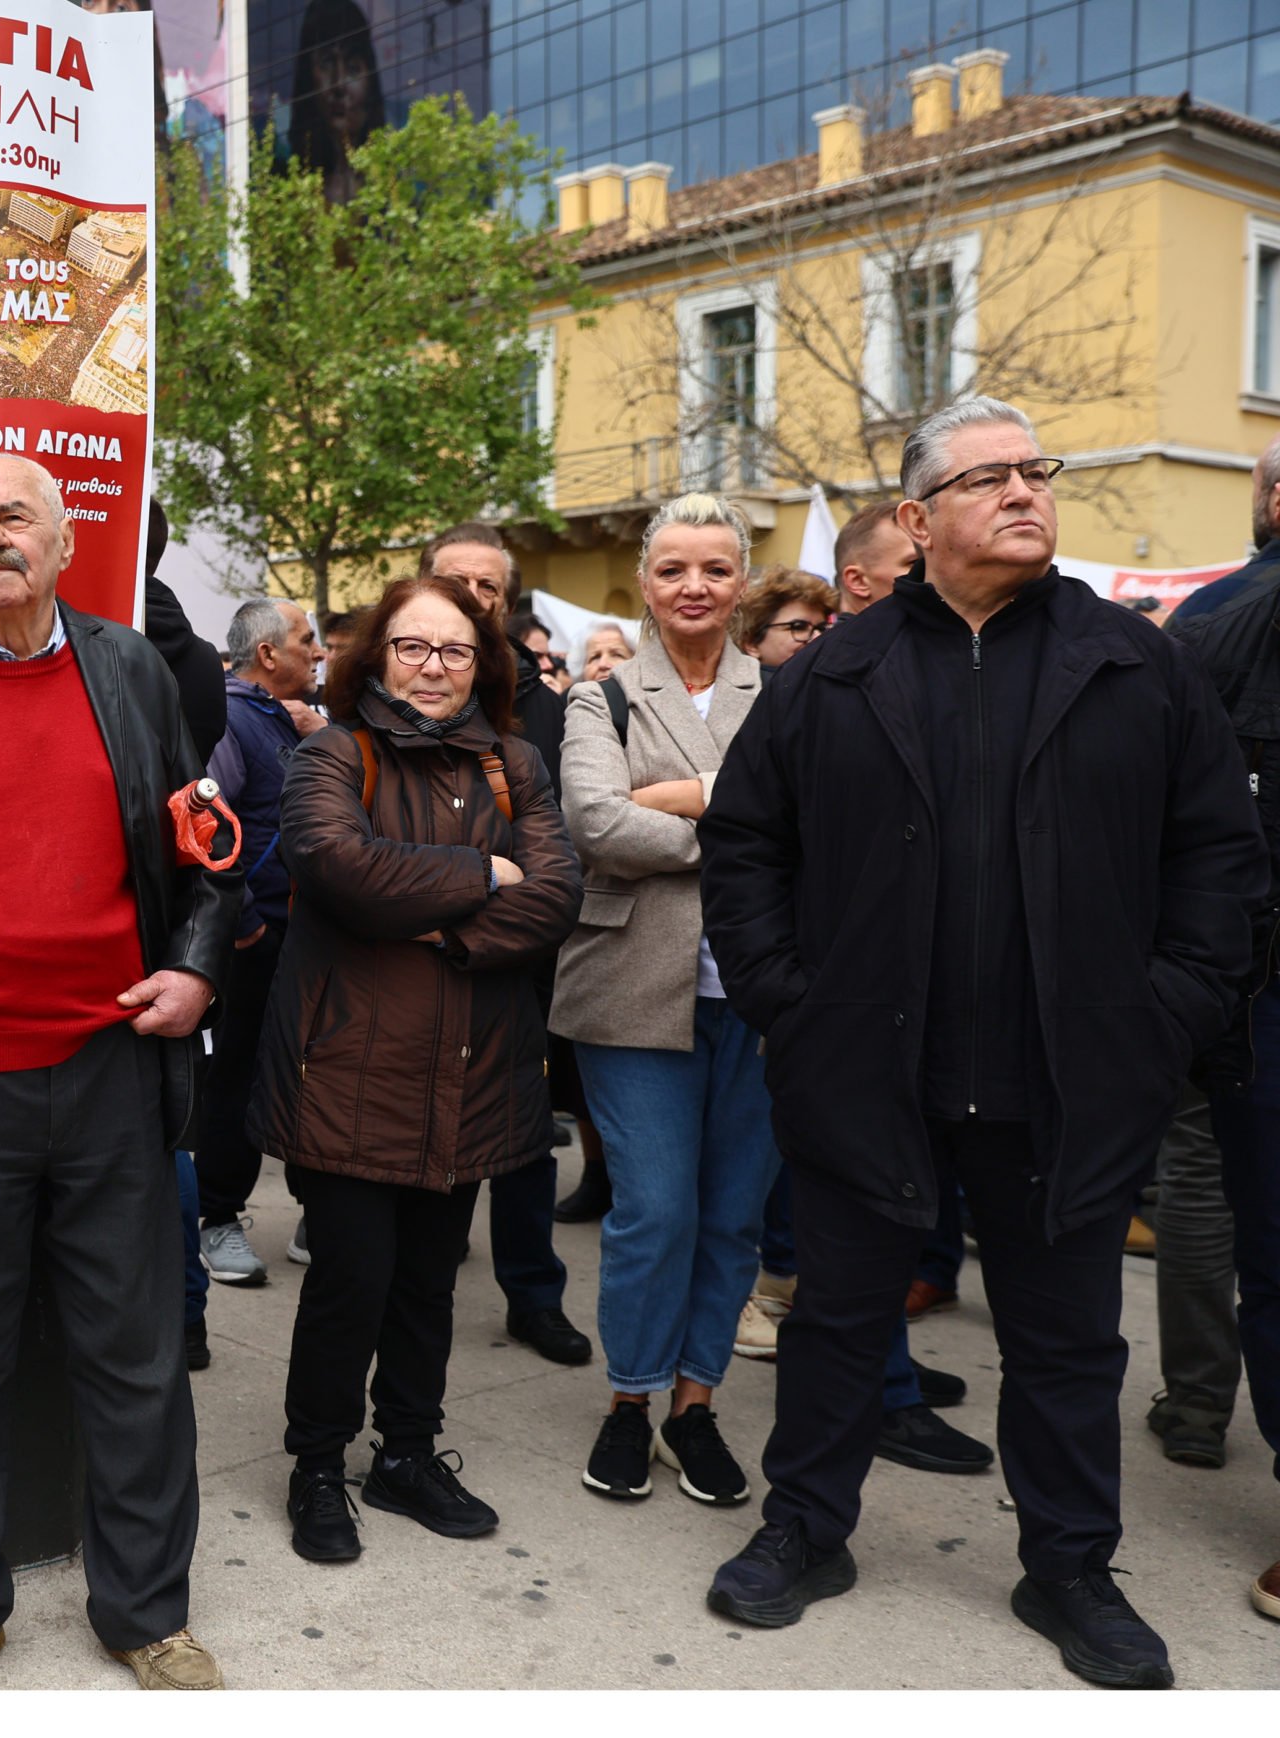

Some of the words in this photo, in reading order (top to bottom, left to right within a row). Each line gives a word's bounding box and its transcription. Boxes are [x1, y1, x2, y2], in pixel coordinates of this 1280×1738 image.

[5, 257, 70, 284] τους
[0, 290, 71, 324] ΜΑΣ
[36, 429, 122, 462] ΑΓΩΝΑ
[66, 477, 122, 497] μισθούς
